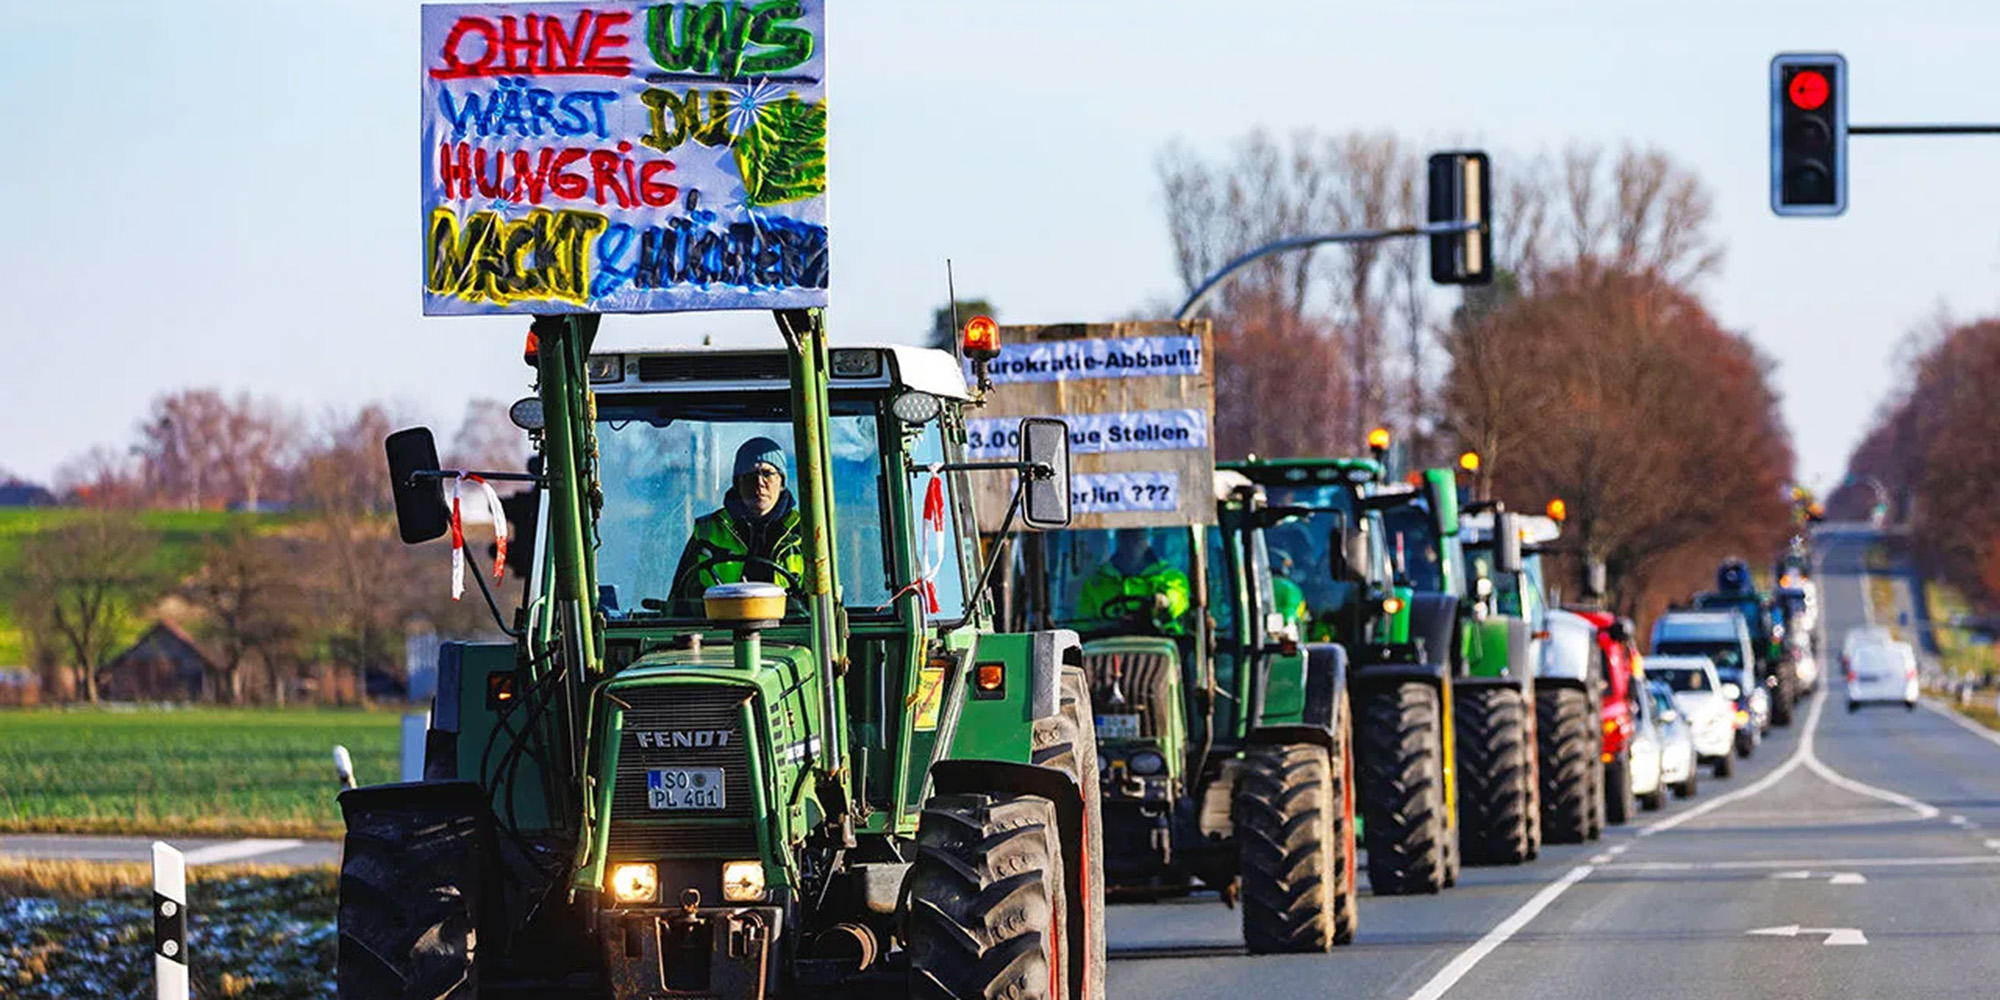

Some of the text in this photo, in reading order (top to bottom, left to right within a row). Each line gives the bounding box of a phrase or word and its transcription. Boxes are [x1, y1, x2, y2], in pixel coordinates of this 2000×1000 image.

[442, 0, 815, 77] OHNE UNS
[438, 77, 738, 150] WÄRST DU
[428, 207, 610, 304] NACKT
[969, 425, 1190, 449] 3.00 ue Stellen
[1072, 484, 1170, 505] erlin ???
[636, 729, 736, 748] FENDT
[664, 771, 690, 789] SO
[655, 789, 718, 807] PL 401
